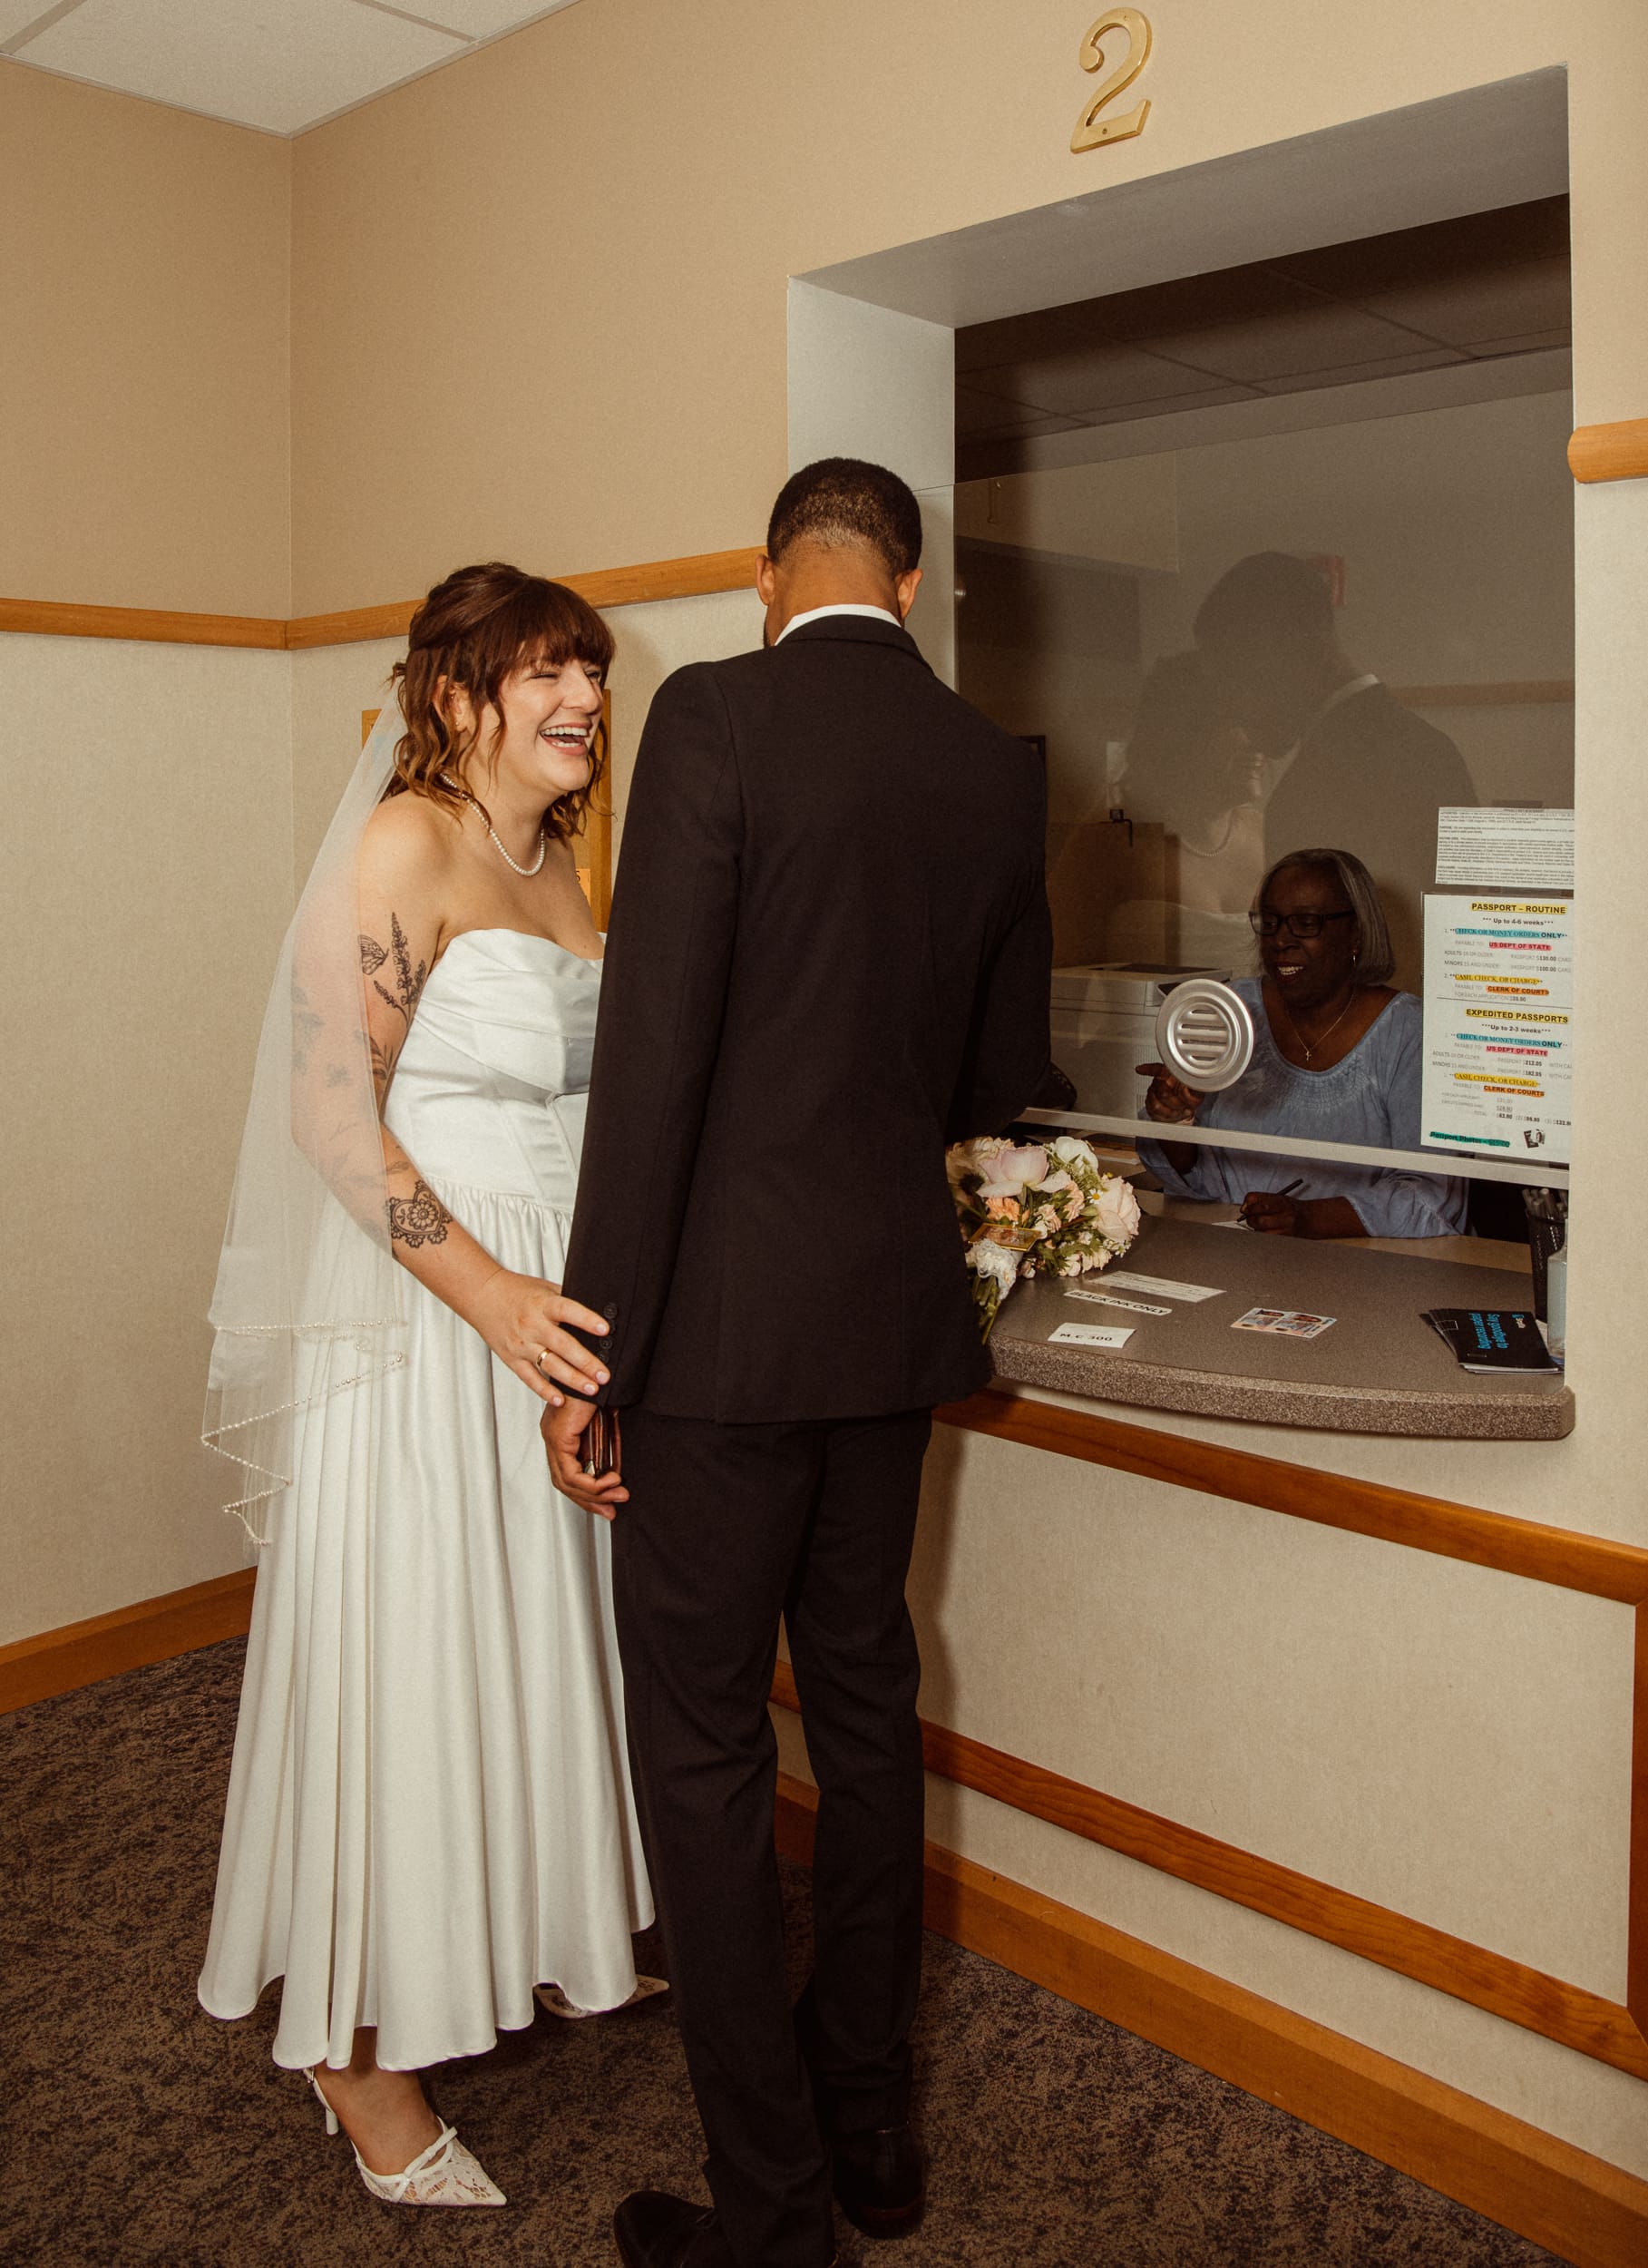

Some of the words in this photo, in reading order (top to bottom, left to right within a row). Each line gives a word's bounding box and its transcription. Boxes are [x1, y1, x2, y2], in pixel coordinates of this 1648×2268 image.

[1070, 7, 1152, 154] 2
[1471, 903, 1516, 912] PASSPORT
[1526, 905, 1566, 914] ROUTINE
[1466, 1009, 1513, 1019] EXPEDITED
[1516, 1012, 1568, 1023] PASSPORTS
[1490, 1036, 1514, 1044] MONEY
[1526, 1049, 1548, 1057] STATE
[1517, 1089, 1545, 1097] COURTS
[1070, 1291, 1108, 1302] BLACK
[1110, 1299, 1132, 1307] INK
[1133, 1305, 1167, 1315] ONLY
